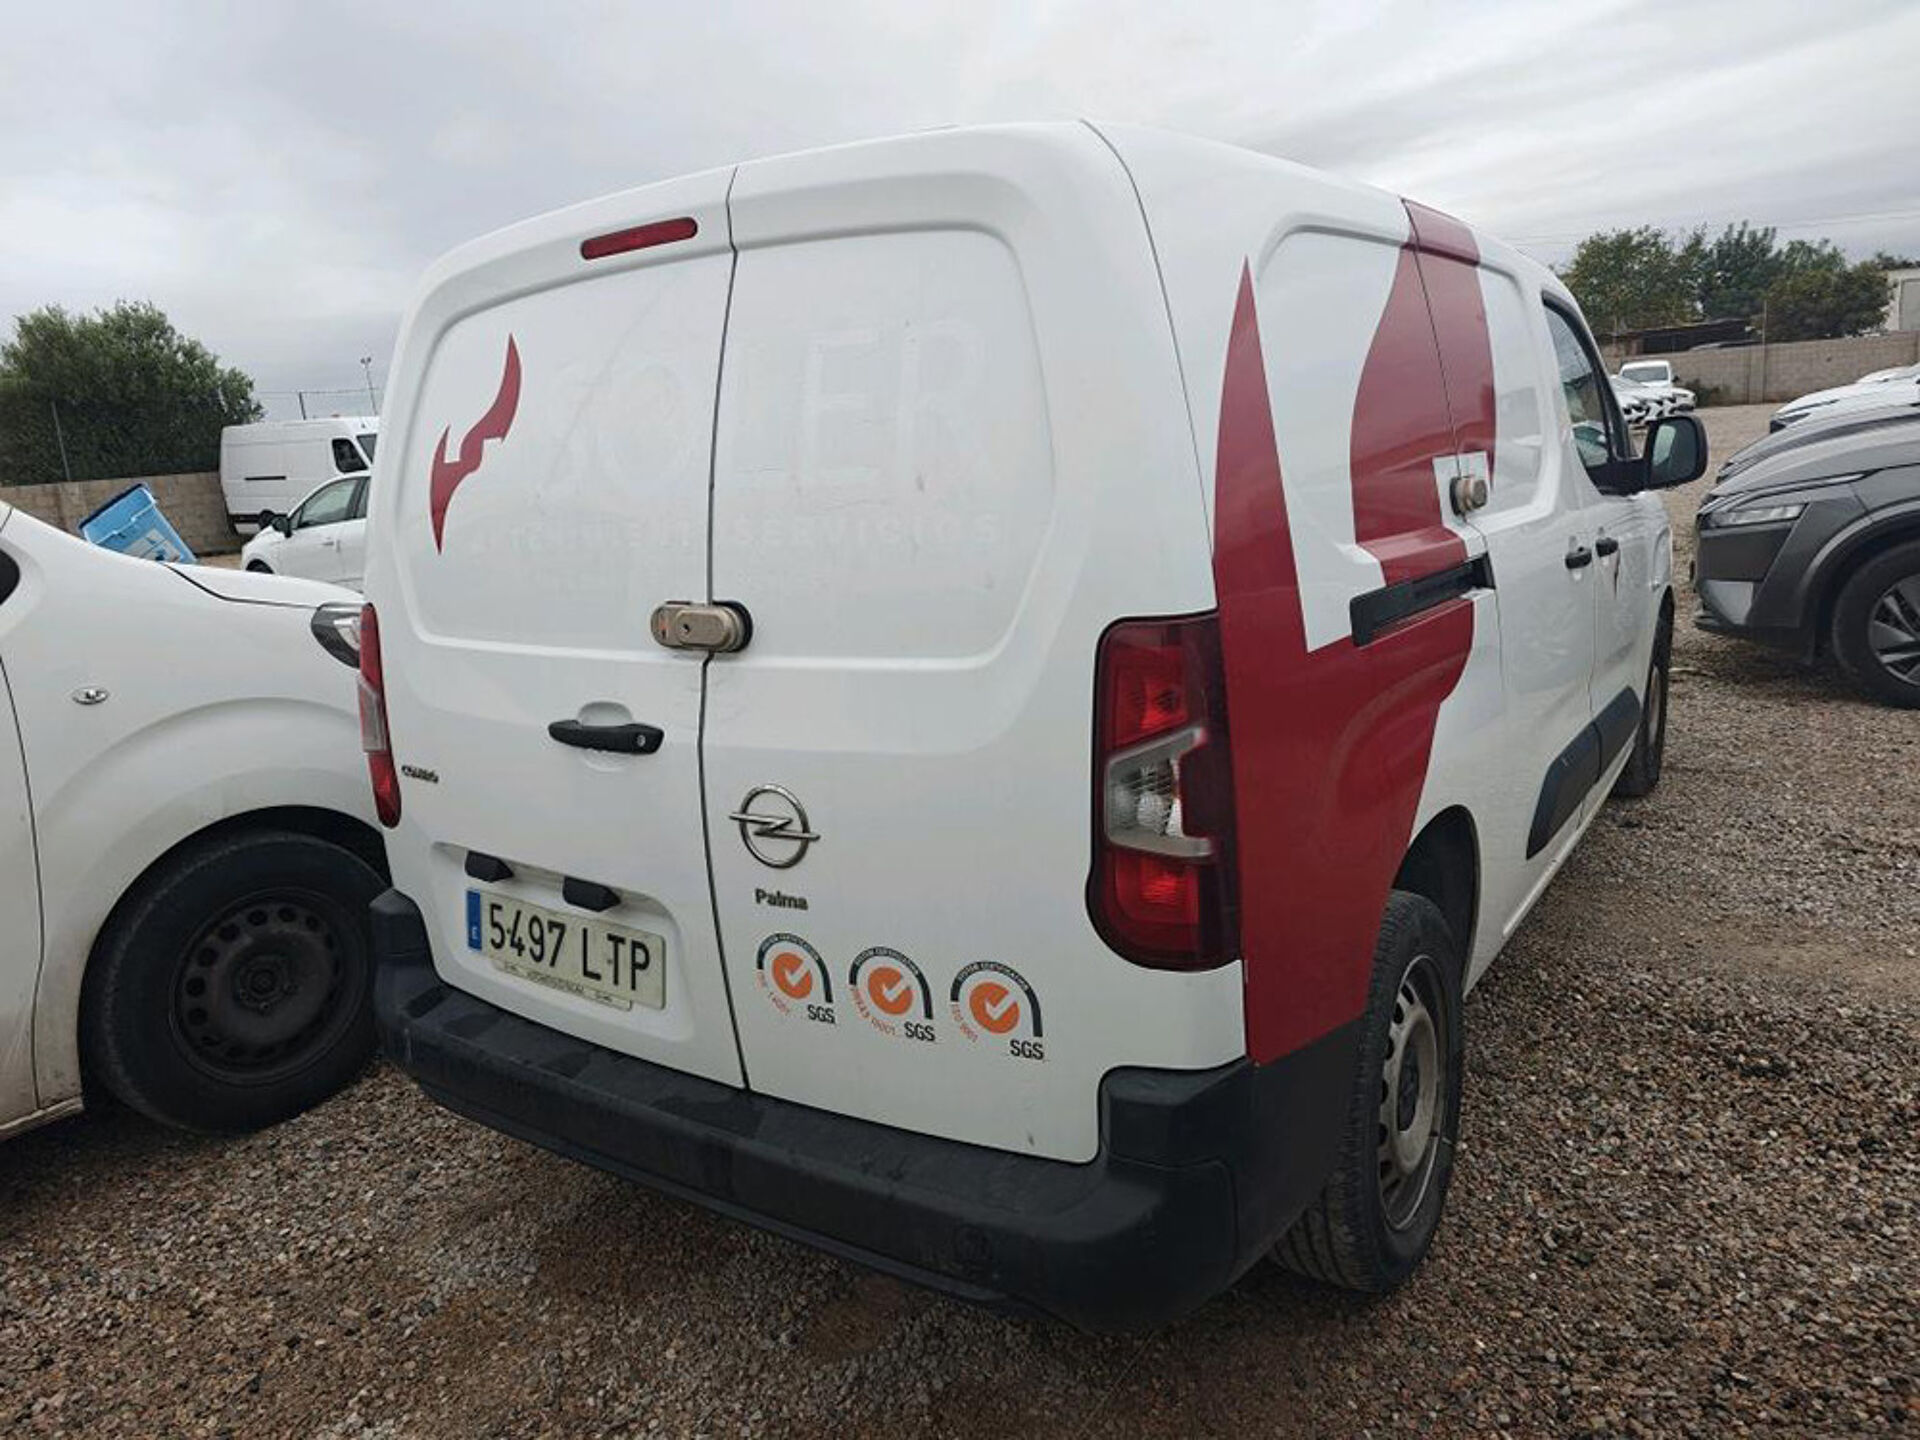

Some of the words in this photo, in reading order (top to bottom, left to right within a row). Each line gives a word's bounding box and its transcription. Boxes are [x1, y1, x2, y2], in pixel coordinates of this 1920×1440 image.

[755, 888, 808, 910] Palma
[490, 903, 566, 968] 5497
[582, 927, 650, 991] LTP
[807, 1004, 835, 1024] SGS
[904, 1021, 935, 1042] SGS
[1010, 1039, 1044, 1060] SGS
